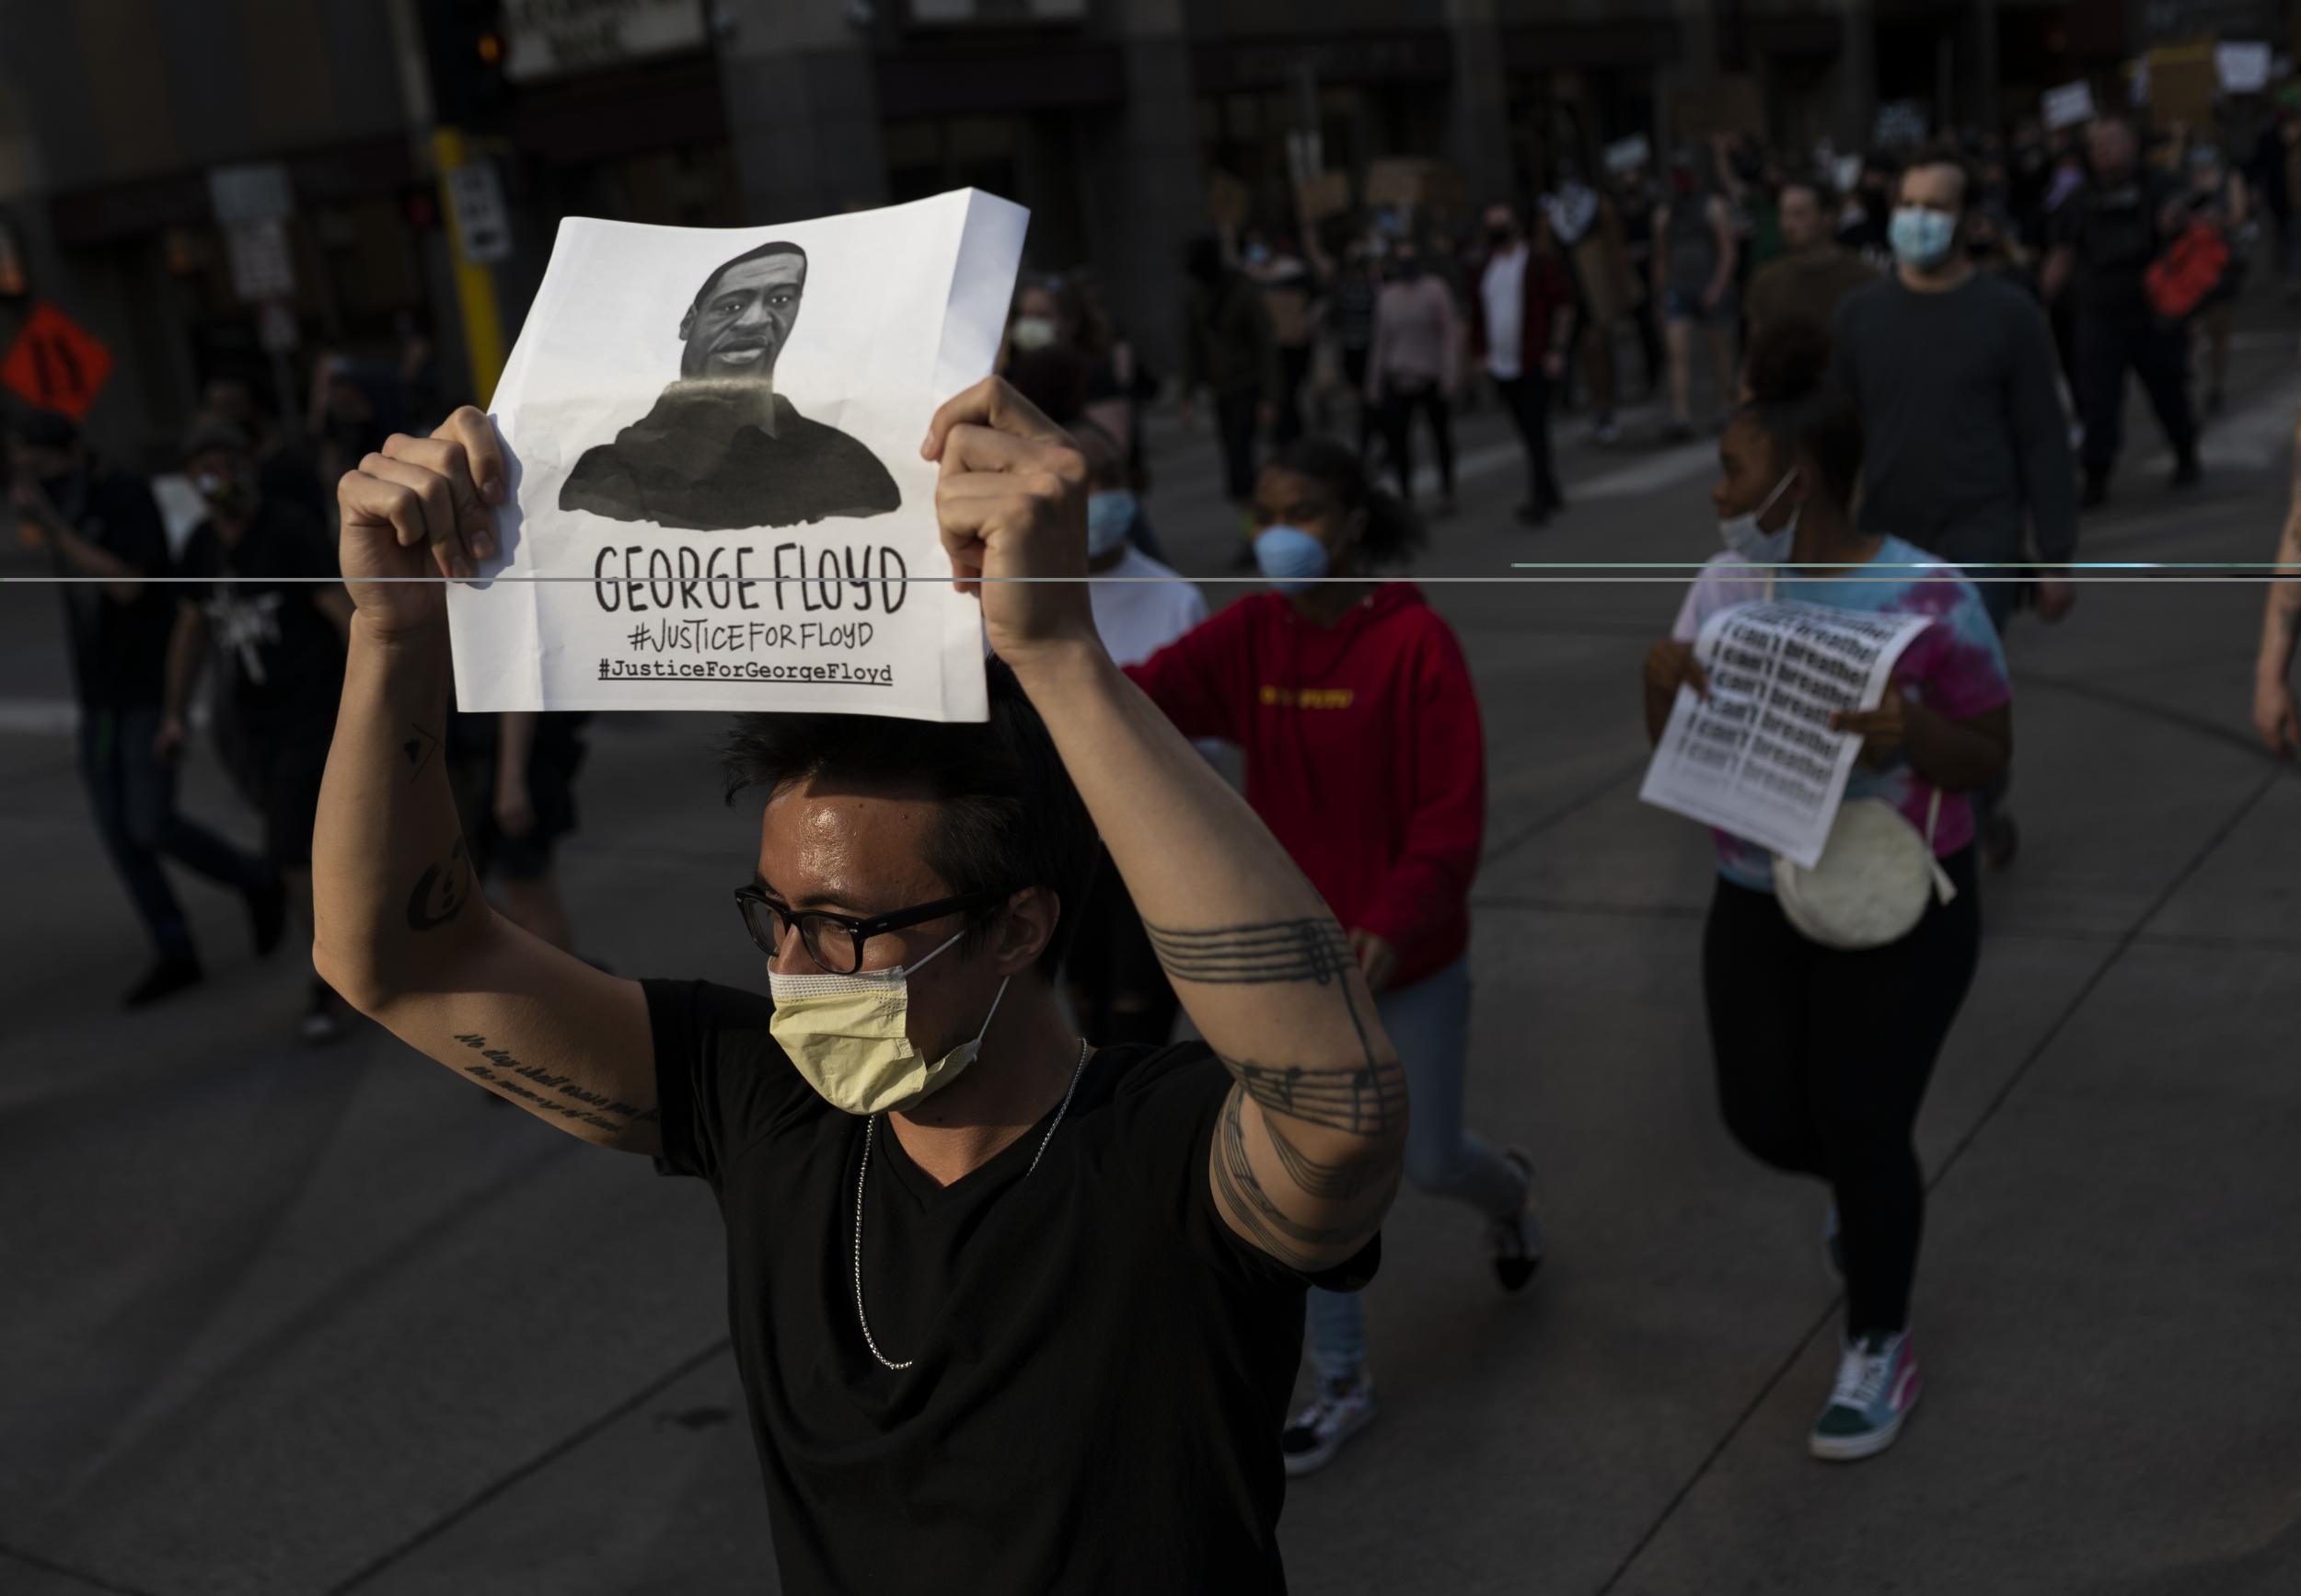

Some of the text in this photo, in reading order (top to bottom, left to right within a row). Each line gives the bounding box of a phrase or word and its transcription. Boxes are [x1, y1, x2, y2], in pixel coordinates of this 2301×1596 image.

[595, 542, 908, 615] GEORGE FLOYD
[627, 618, 874, 653] #JUSTICEFORFLOYD
[598, 658, 894, 687] #JusticeForGeorgeFloyd
